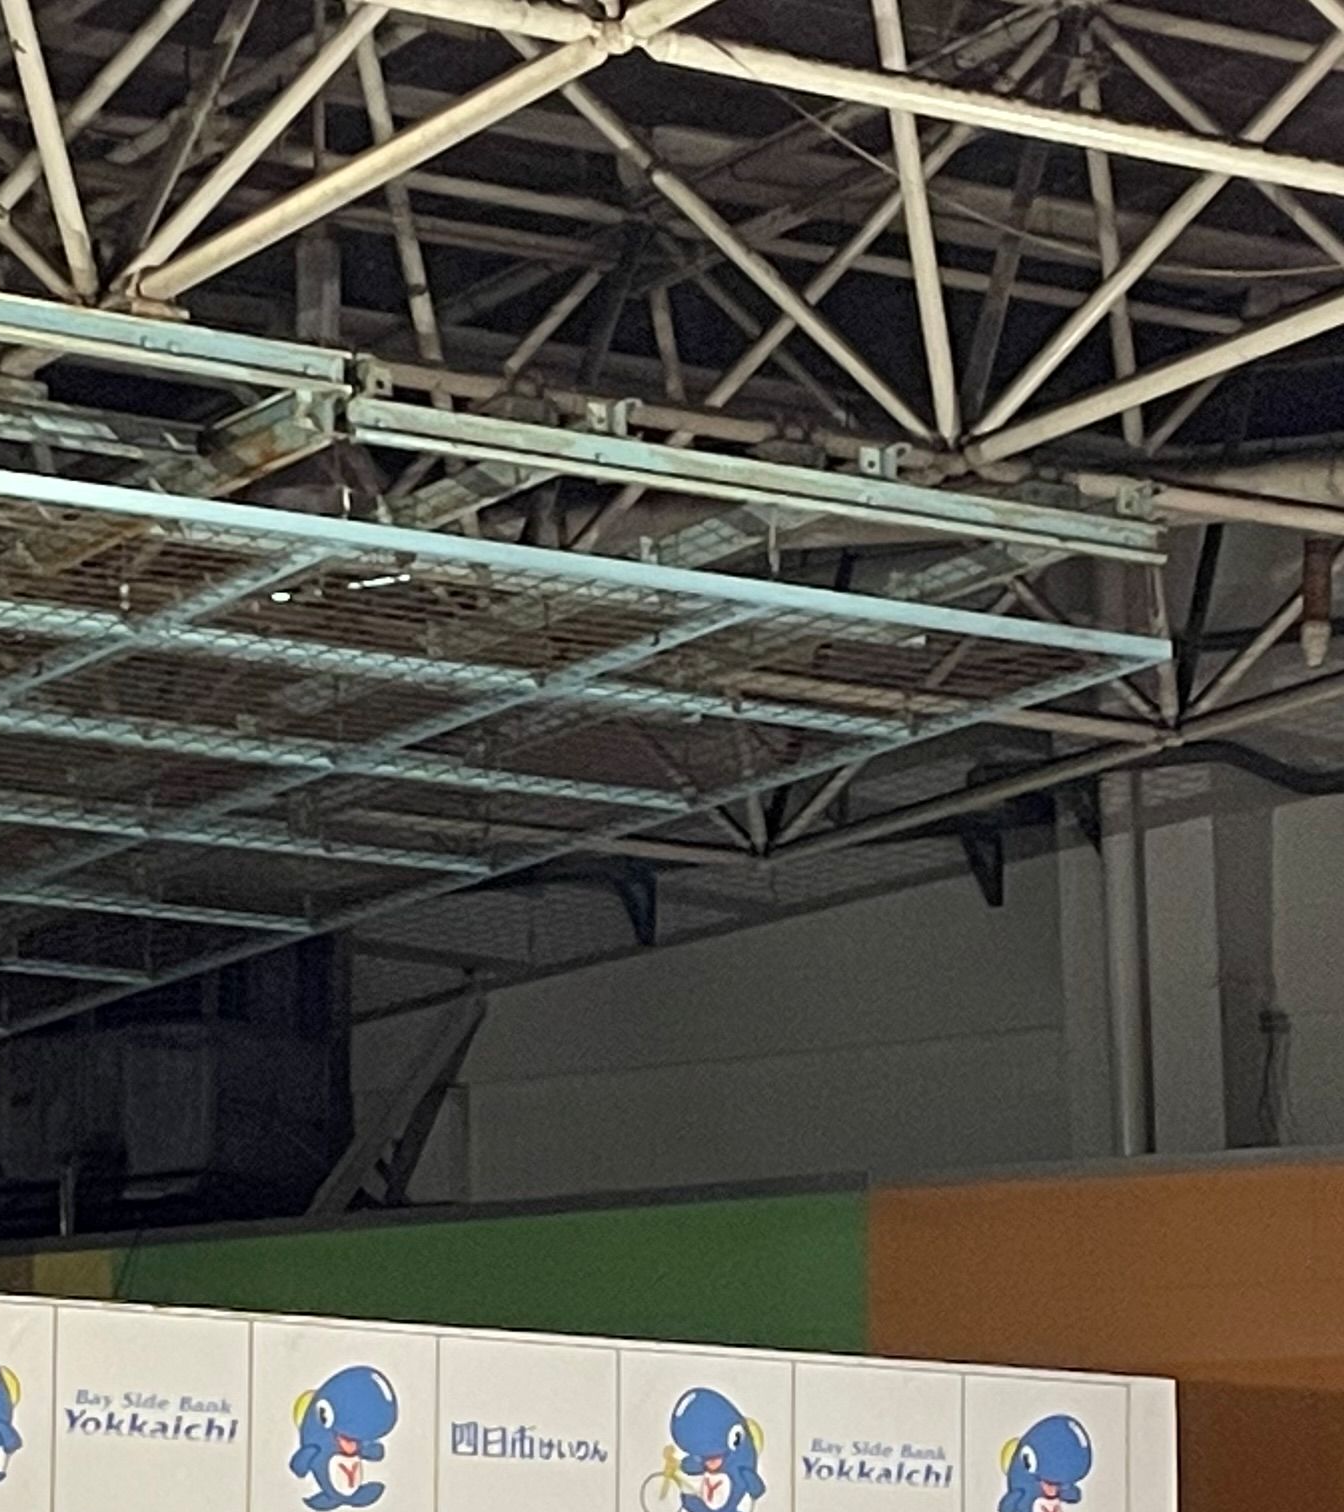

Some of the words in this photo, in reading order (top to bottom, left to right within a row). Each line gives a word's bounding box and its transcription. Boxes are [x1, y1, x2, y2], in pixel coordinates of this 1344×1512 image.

[75, 1388, 113, 1410] Bay
[122, 1391, 171, 1410] Side
[178, 1395, 231, 1414] Bank
[64, 1408, 238, 1443] Yokkaichi
[451, 1422, 608, 1463] 四日市けいりん
[810, 1437, 844, 1456] Bay
[851, 1440, 894, 1458] Side
[900, 1443, 947, 1461] Bank
[339, 1462, 358, 1487] Y
[802, 1456, 953, 1488] Yokkaichi
[704, 1477, 722, 1502] Y
